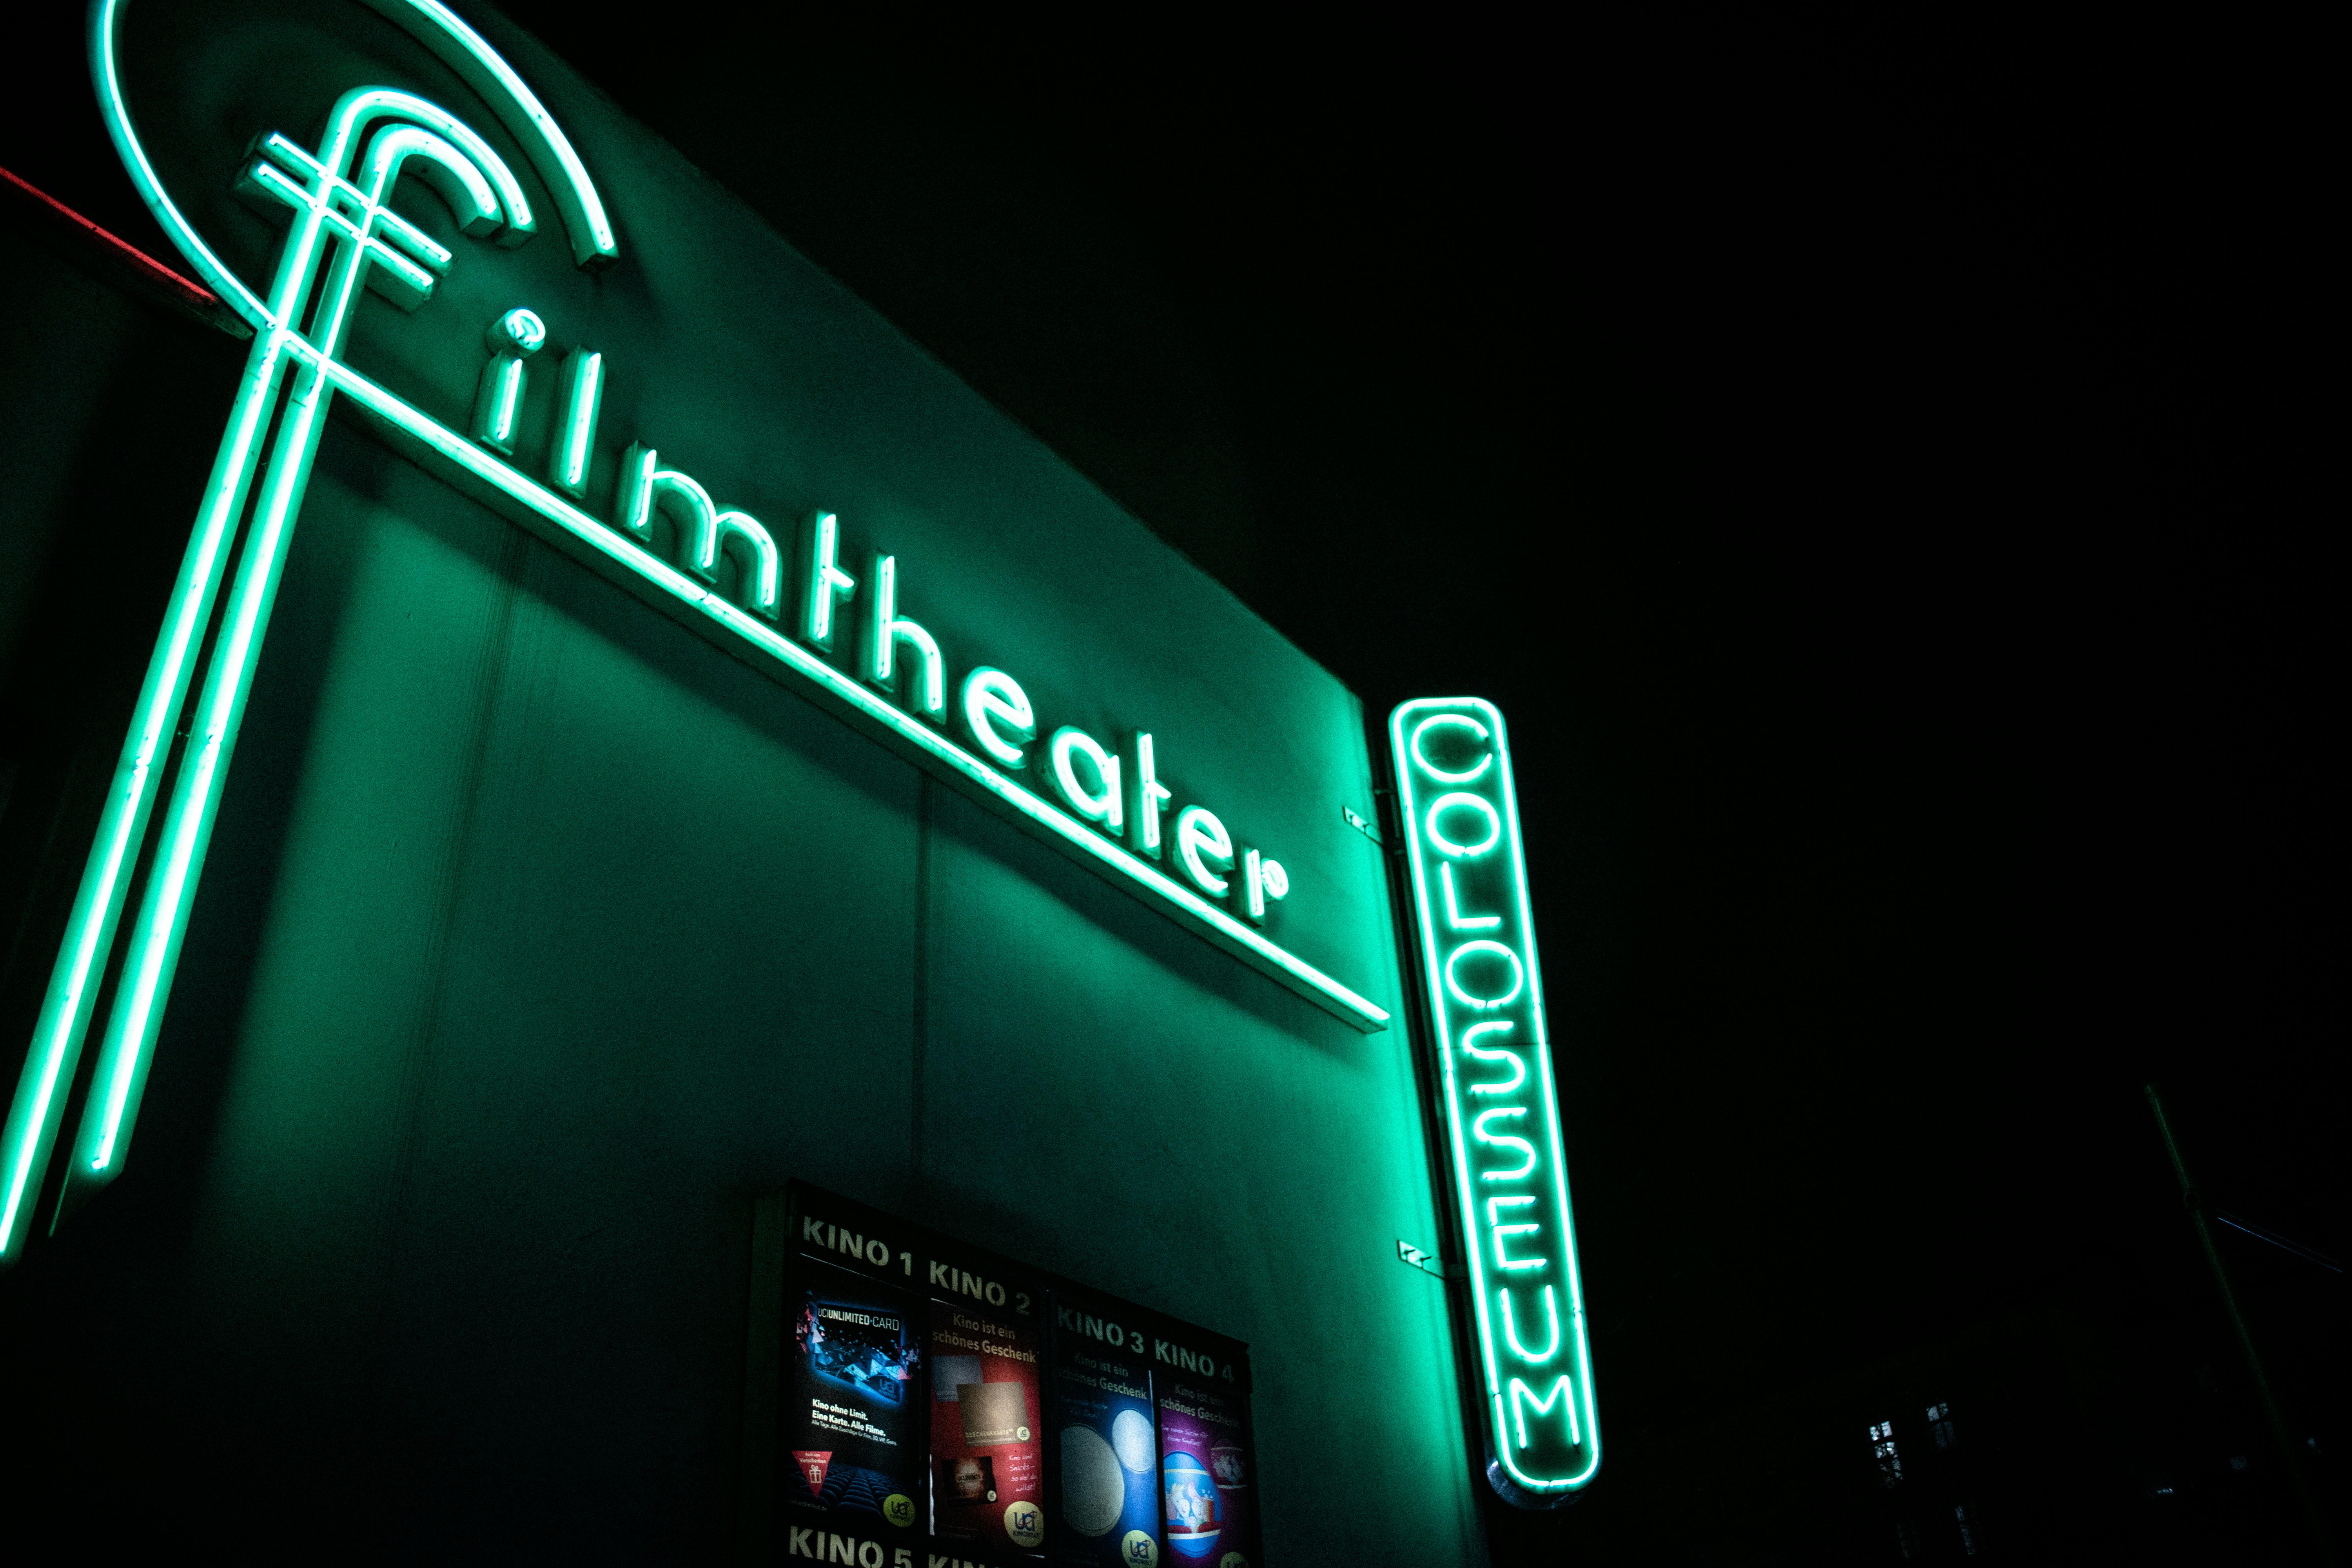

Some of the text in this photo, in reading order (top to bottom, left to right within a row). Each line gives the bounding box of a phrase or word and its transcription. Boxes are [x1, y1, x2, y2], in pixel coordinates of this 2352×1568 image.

[1411, 713, 1581, 1449] COLOSSEUM
[803, 1216, 912, 1276] KINO 1
[929, 1260, 1030, 1316] KINO 2
[933, 1330, 979, 1350] schönes
[953, 1313, 1015, 1339] Kino ist ein
[1058, 1305, 1144, 1354] KINO 3
[1074, 1352, 1129, 1377] Kino ist ein
[1155, 1338, 1235, 1384] KINO 4
[1058, 1367, 1147, 1399] schönes Geschenk
[1174, 1383, 1194, 1399] Kino
[812, 1398, 868, 1421] Kino ohne Limit.
[1160, 1397, 1195, 1416] schönes
[812, 1410, 886, 1437] Eine Karte. Alle Filme.
[789, 1524, 884, 1568] KINO
[894, 1548, 913, 1568] 5
